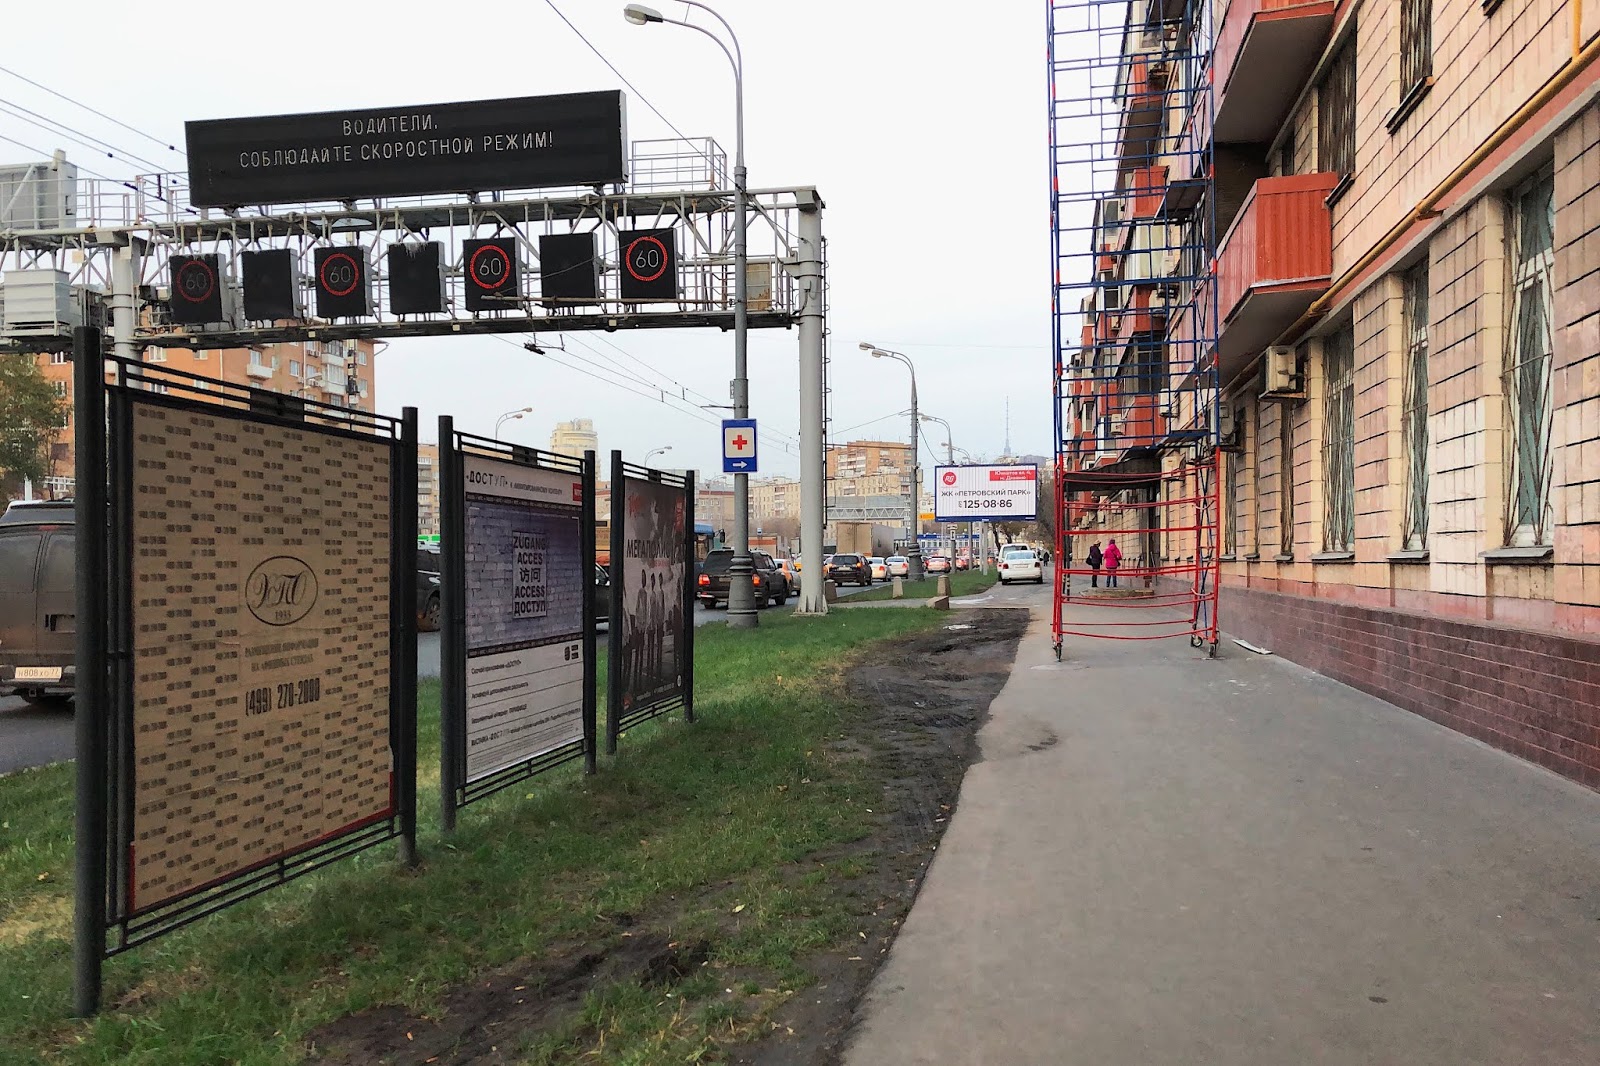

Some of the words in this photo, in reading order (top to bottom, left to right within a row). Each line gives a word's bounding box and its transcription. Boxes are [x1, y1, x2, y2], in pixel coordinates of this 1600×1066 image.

[240, 145, 352, 168] СОБЛЮДАЙТЕ
[360, 137, 473, 160] СКОРОСТНОЙ
[483, 130, 553, 152] РЕЖИМ!
[479, 257, 502, 276] 60
[635, 249, 659, 269] 60
[185, 272, 208, 290] 60
[329, 265, 351, 284] 60
[512, 536, 546, 551] ZUGANG
[517, 552, 543, 565] ACCES
[519, 567, 541, 583] 访问
[514, 585, 545, 599] ACCESS
[514, 600, 546, 616] ДОСТУП
[245, 687, 272, 717] (499)
